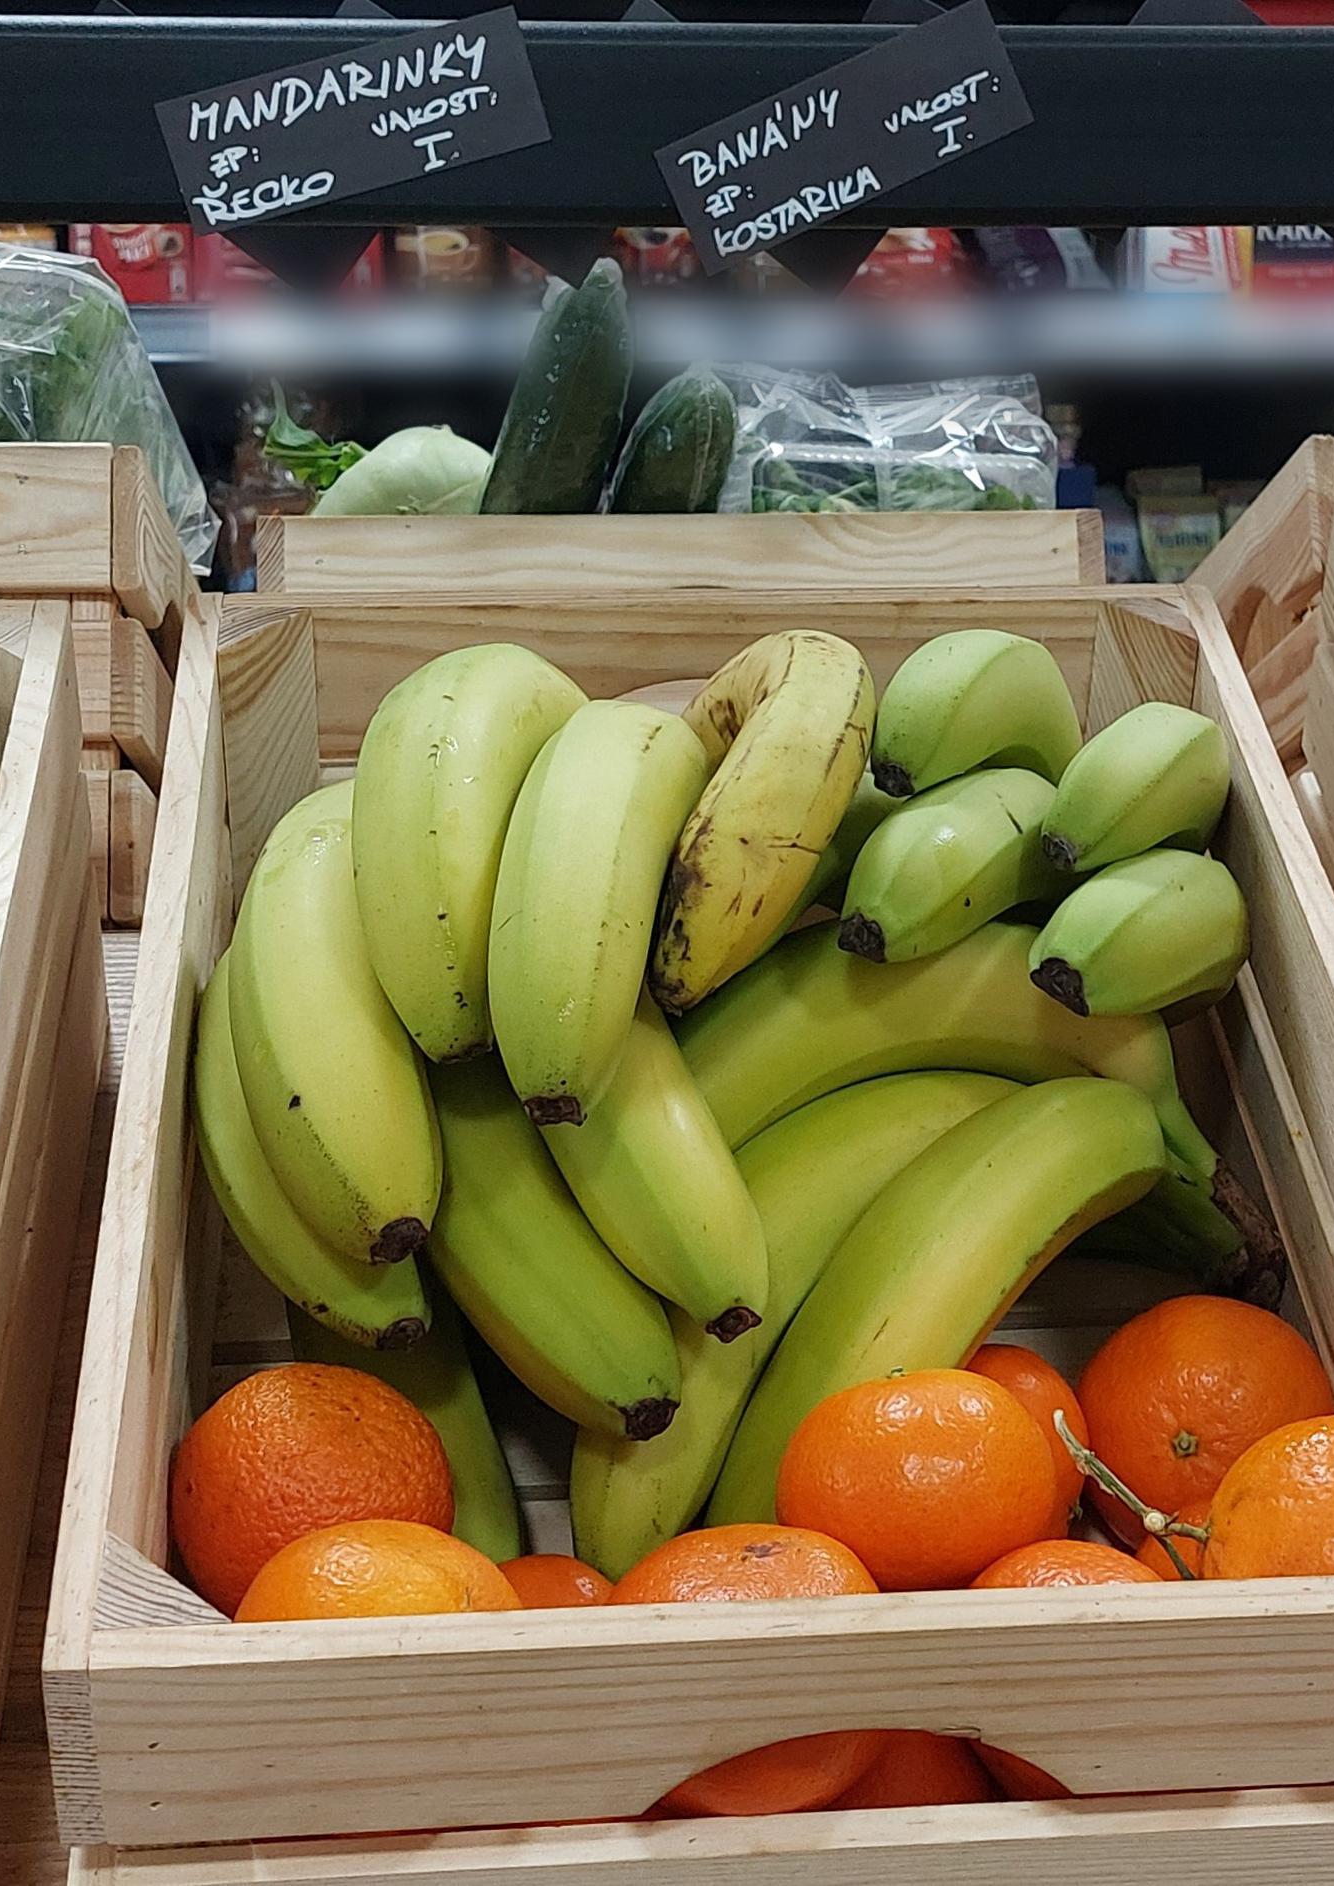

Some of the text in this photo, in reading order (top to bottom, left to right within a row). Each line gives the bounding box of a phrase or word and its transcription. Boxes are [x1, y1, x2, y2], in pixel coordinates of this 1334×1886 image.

[188, 33, 487, 142] MANDARINKY
[370, 86, 498, 137] JAKOST:
[883, 70, 1001, 134] JAKOST:
[413, 131, 461, 172] I.
[677, 88, 841, 188] BANÁNY
[931, 115, 975, 158] I.
[191, 171, 335, 226] ŘECKO
[712, 165, 882, 257] KOSTARIKA
